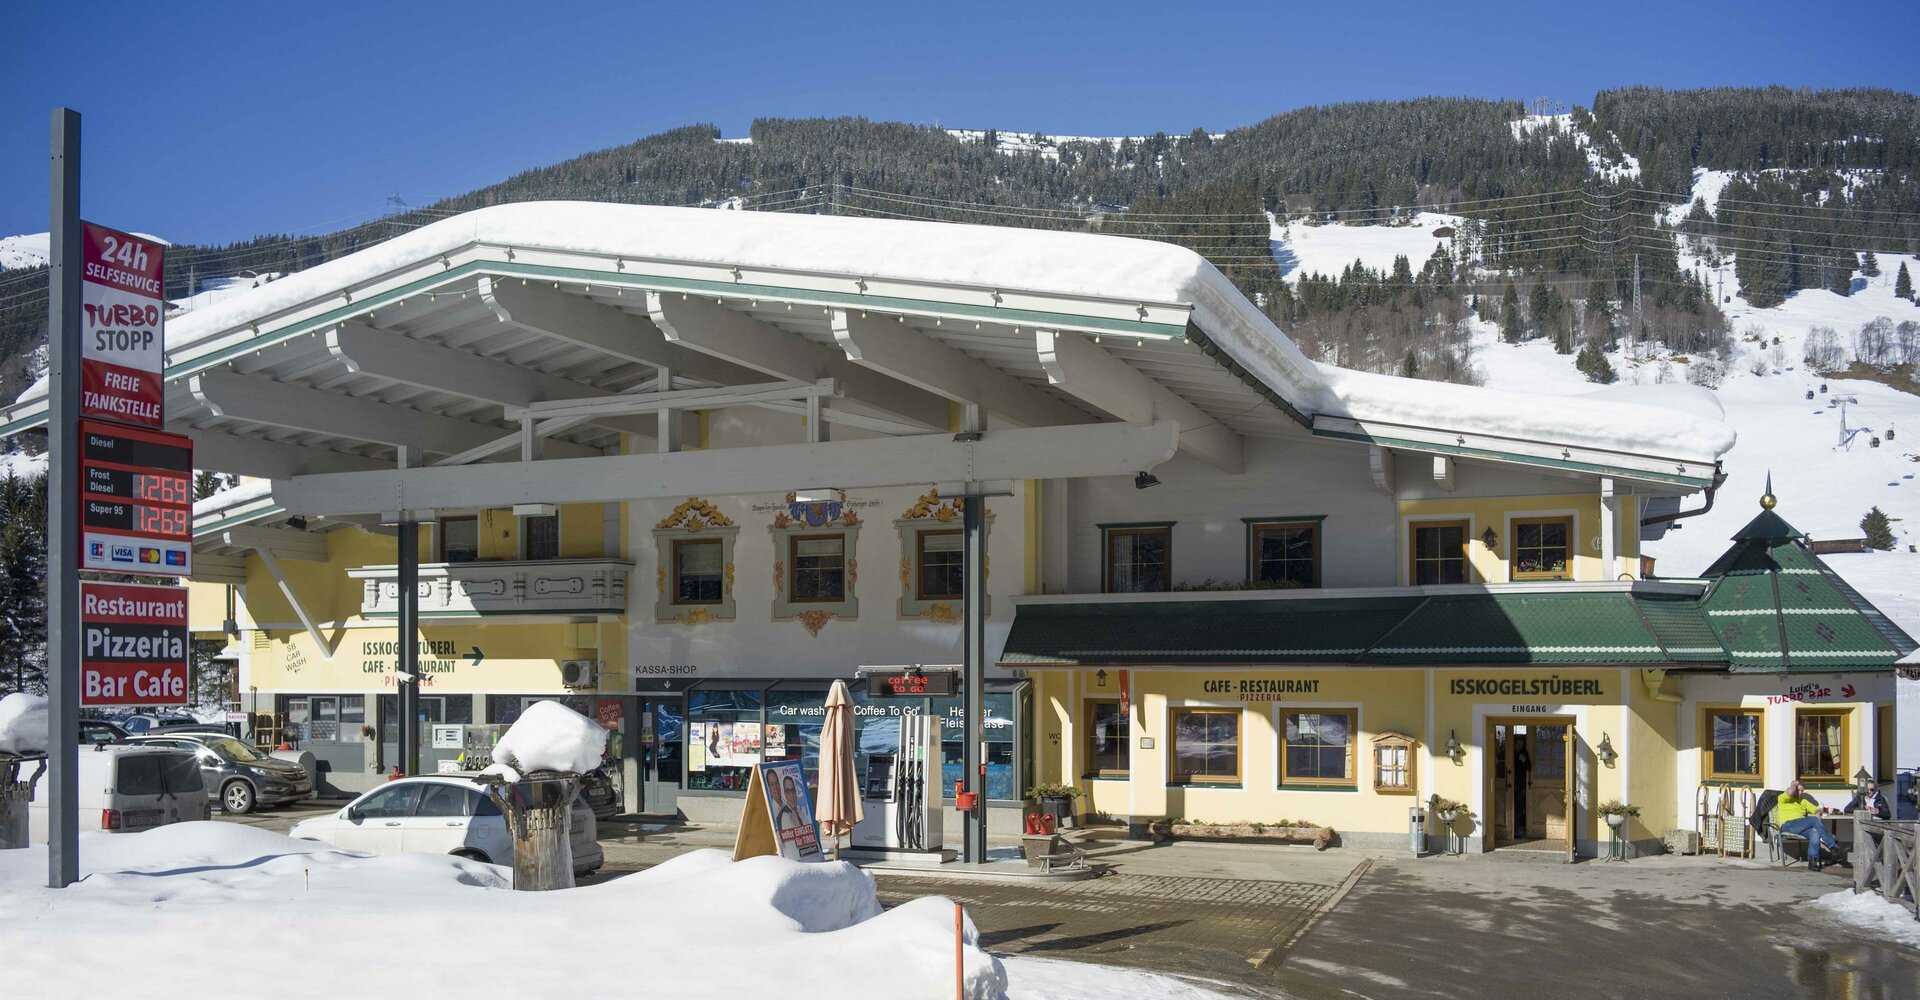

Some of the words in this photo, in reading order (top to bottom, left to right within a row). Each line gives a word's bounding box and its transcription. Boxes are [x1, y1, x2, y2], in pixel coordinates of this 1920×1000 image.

[101, 236, 148, 272] 24h
[86, 262, 160, 293] SELFSERVICE
[83, 303, 159, 328] TURBO
[96, 329, 154, 351] STOPP
[104, 372, 140, 393] FREIE
[84, 391, 160, 419] TANKSTELLE
[90, 436, 114, 449] Diesel
[90, 469, 110, 480] Frost
[90, 482, 114, 493] Diesel
[141, 474, 187, 505] 1.269
[90, 503, 112, 515] Super
[113, 506, 123, 516] 95
[141, 506, 187, 536] 1.269
[114, 548, 133, 557] VISA
[85, 593, 184, 619] Restaurant
[87, 627, 183, 659] Pizzeria
[286, 643, 297, 652] SB
[286, 651, 301, 662] CAR
[286, 657, 307, 672] WASH
[362, 660, 384, 673] CAFE
[635, 665, 697, 675] KASSA-SHOP
[86, 670, 128, 698] Bar
[133, 668, 184, 698] Cafe
[888, 675, 928, 685] coffee
[1203, 680, 1231, 693] CAFE
[1240, 680, 1320, 693] RESTAURANT
[1450, 674, 1604, 696] ISSKOGELSTÜBERL
[893, 685, 906, 693] to
[1789, 682, 1820, 694] Luigi's
[1766, 692, 1804, 706] TURBO
[1808, 687, 1832, 699] BAR
[780, 705, 798, 716] Car
[800, 705, 825, 716] wash
[889, 705, 900, 716] To
[1512, 705, 1547, 713] EINGANG
[1048, 732, 1062, 740] WC
